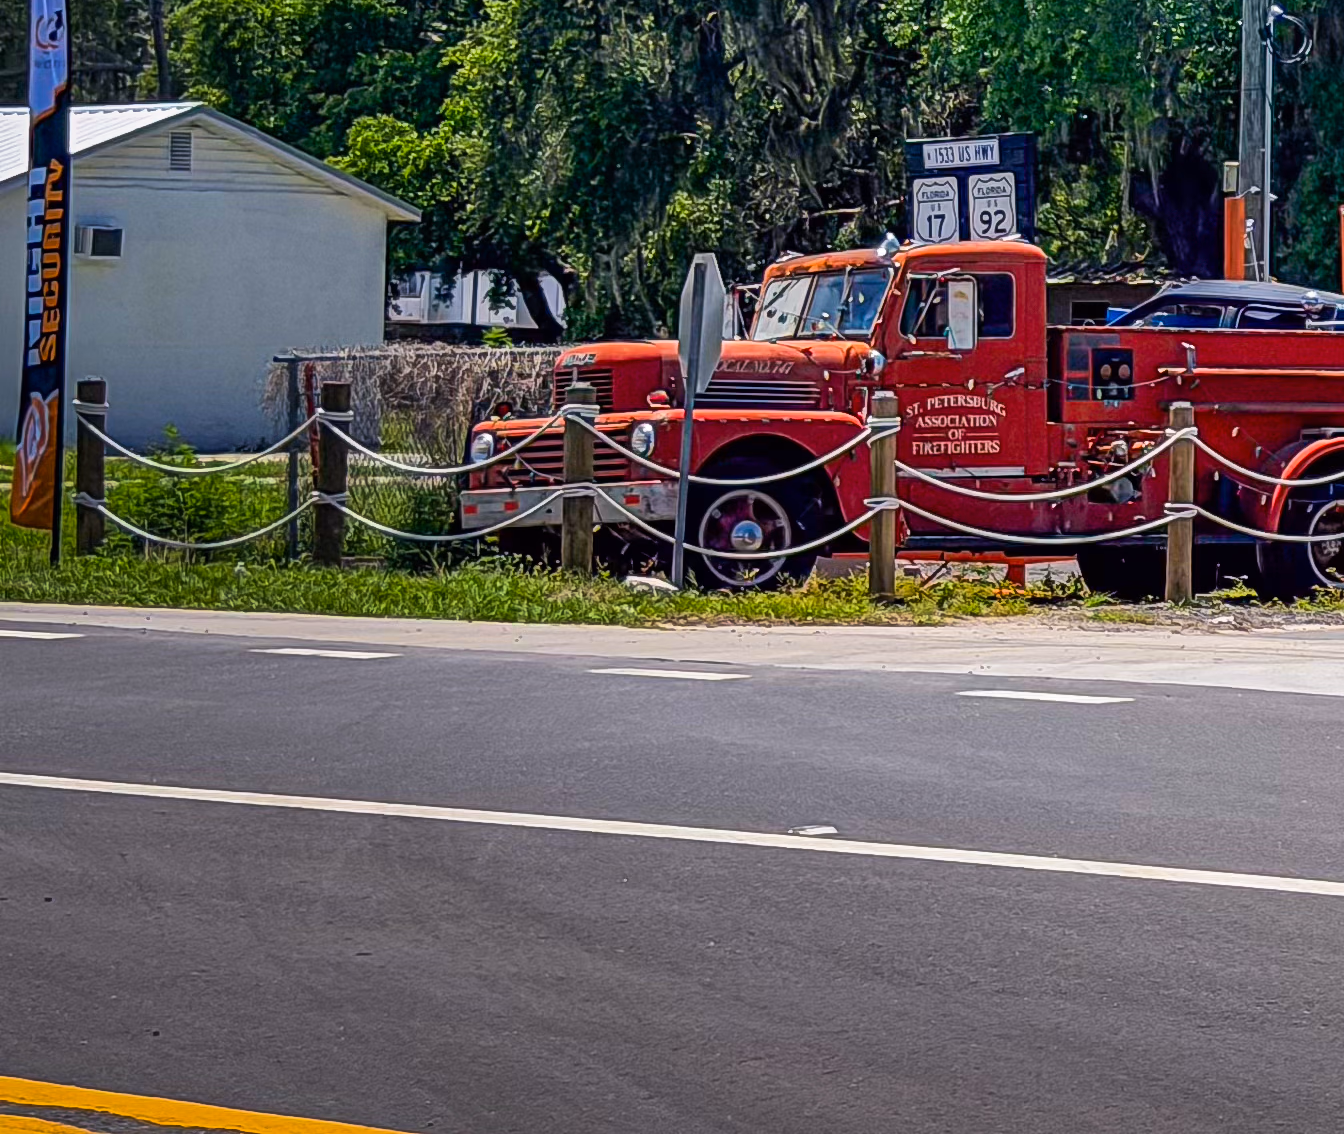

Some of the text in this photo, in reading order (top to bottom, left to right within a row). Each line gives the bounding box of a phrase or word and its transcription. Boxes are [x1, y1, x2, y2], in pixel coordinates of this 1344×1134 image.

[934, 146, 955, 164] 1533
[958, 146, 971, 163] US
[974, 144, 995, 161] HWY
[921, 190, 950, 199] FLORIDA
[977, 186, 1007, 196] FLORIDA
[926, 213, 946, 239] 17
[979, 209, 1007, 235] 92
[39, 157, 64, 362] SECURITY
[714, 359, 752, 373] OCAL
[906, 394, 1006, 418] ST. PETERSBURG
[915, 414, 997, 428] ASSOCIATION
[948, 428, 966, 440] OF
[912, 440, 1000, 455] FIREFIGHTERS
